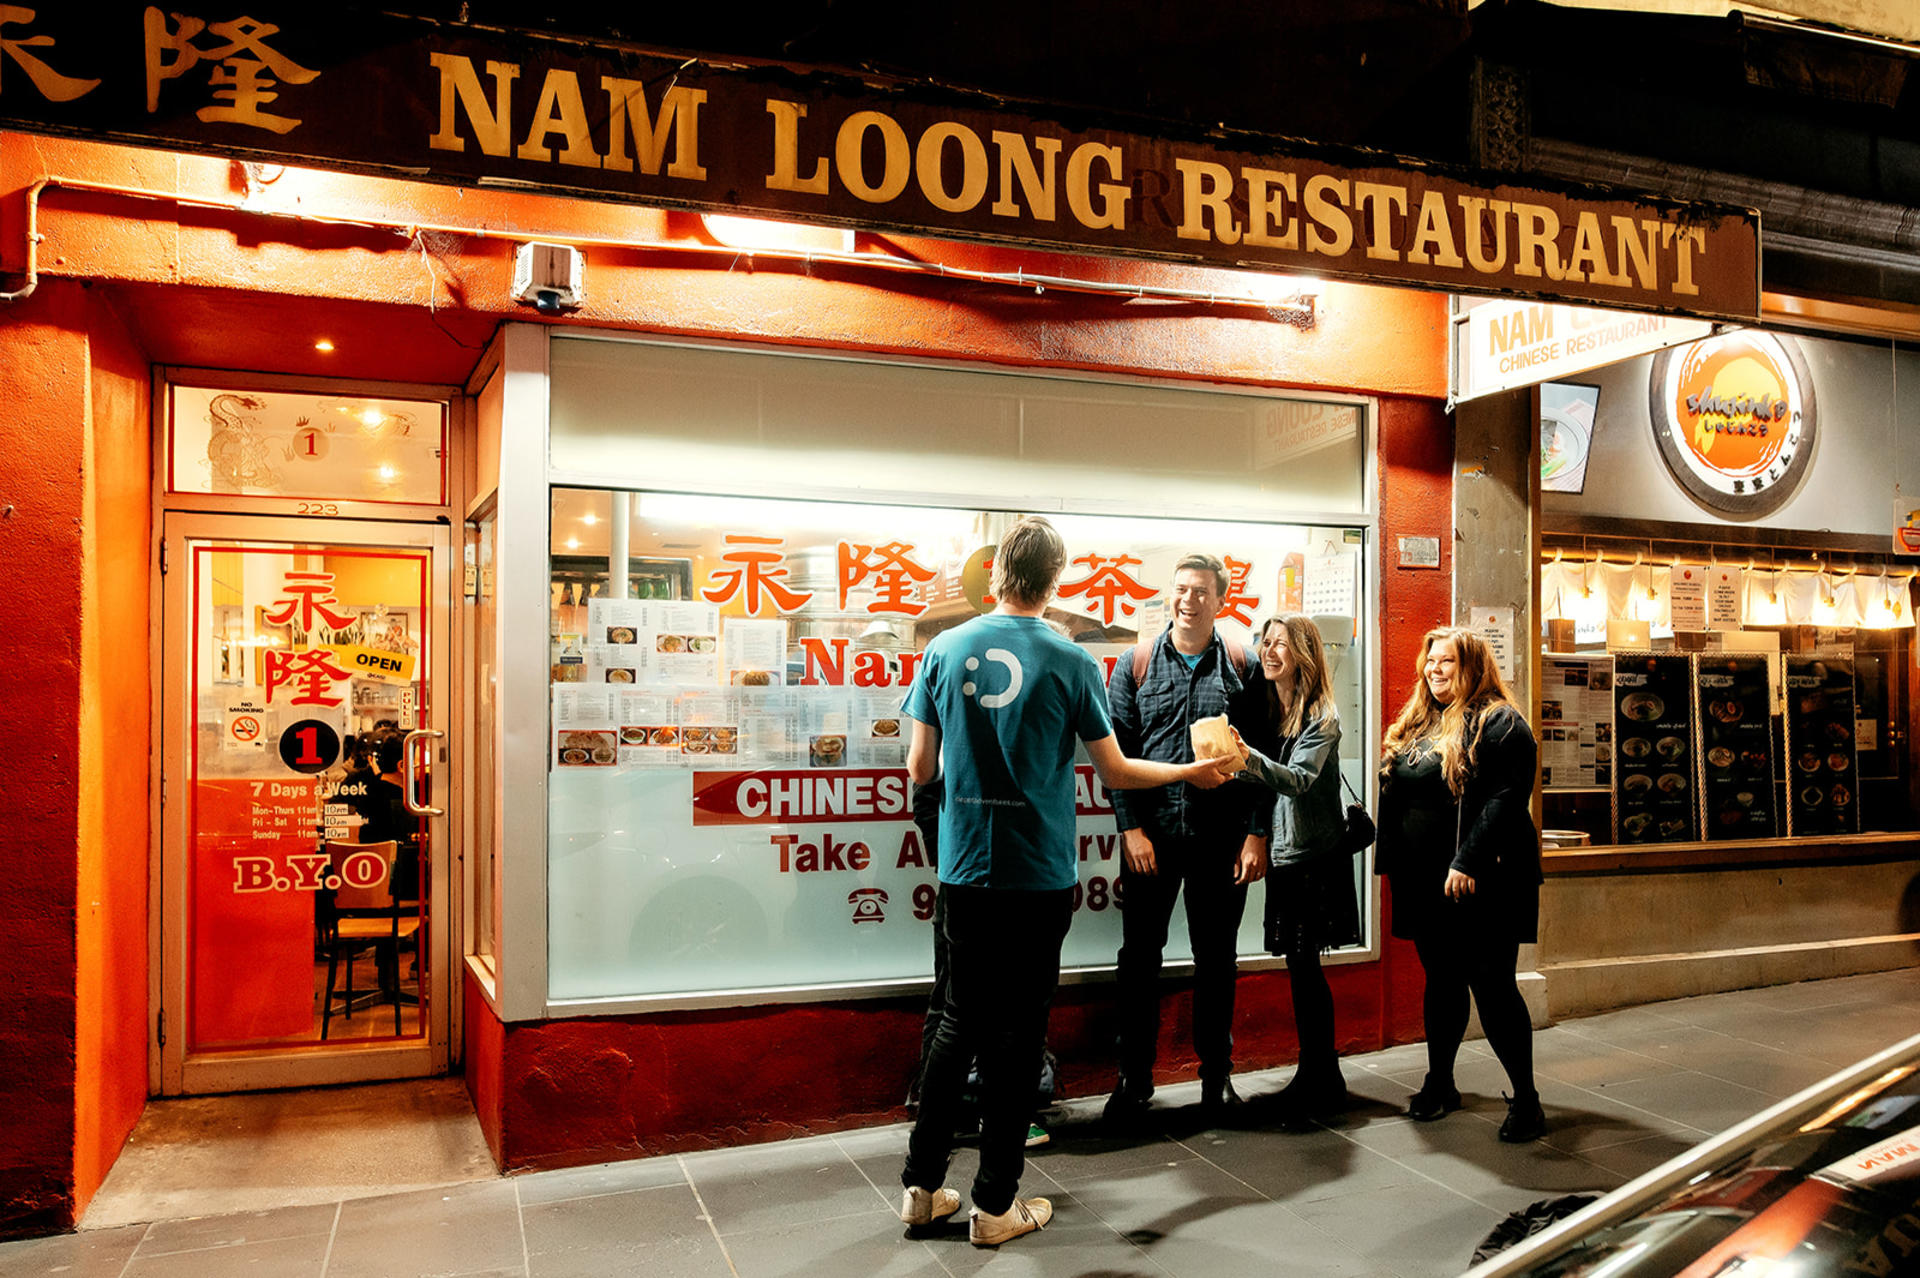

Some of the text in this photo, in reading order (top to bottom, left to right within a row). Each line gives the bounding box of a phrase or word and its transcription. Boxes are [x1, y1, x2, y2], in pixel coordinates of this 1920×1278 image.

[429, 52, 707, 182] NAM
[766, 98, 1131, 231] LOONG
[1175, 158, 1705, 296] RESTAURANT
[1489, 303, 1554, 357] NAM
[1499, 342, 1560, 374] CHINESE
[1566, 315, 1668, 356] RESTAURANT
[303, 432, 318, 456] 1
[297, 503, 339, 516] 223
[356, 653, 403, 672] OPEN
[402, 691, 411, 717] PULL
[295, 727, 323, 764] 1
[250, 782, 367, 799] 7 Days a Week
[252, 817, 265, 827] Fri
[274, 817, 288, 827] Sat
[252, 830, 281, 841] Sunday
[771, 833, 870, 873] Take
